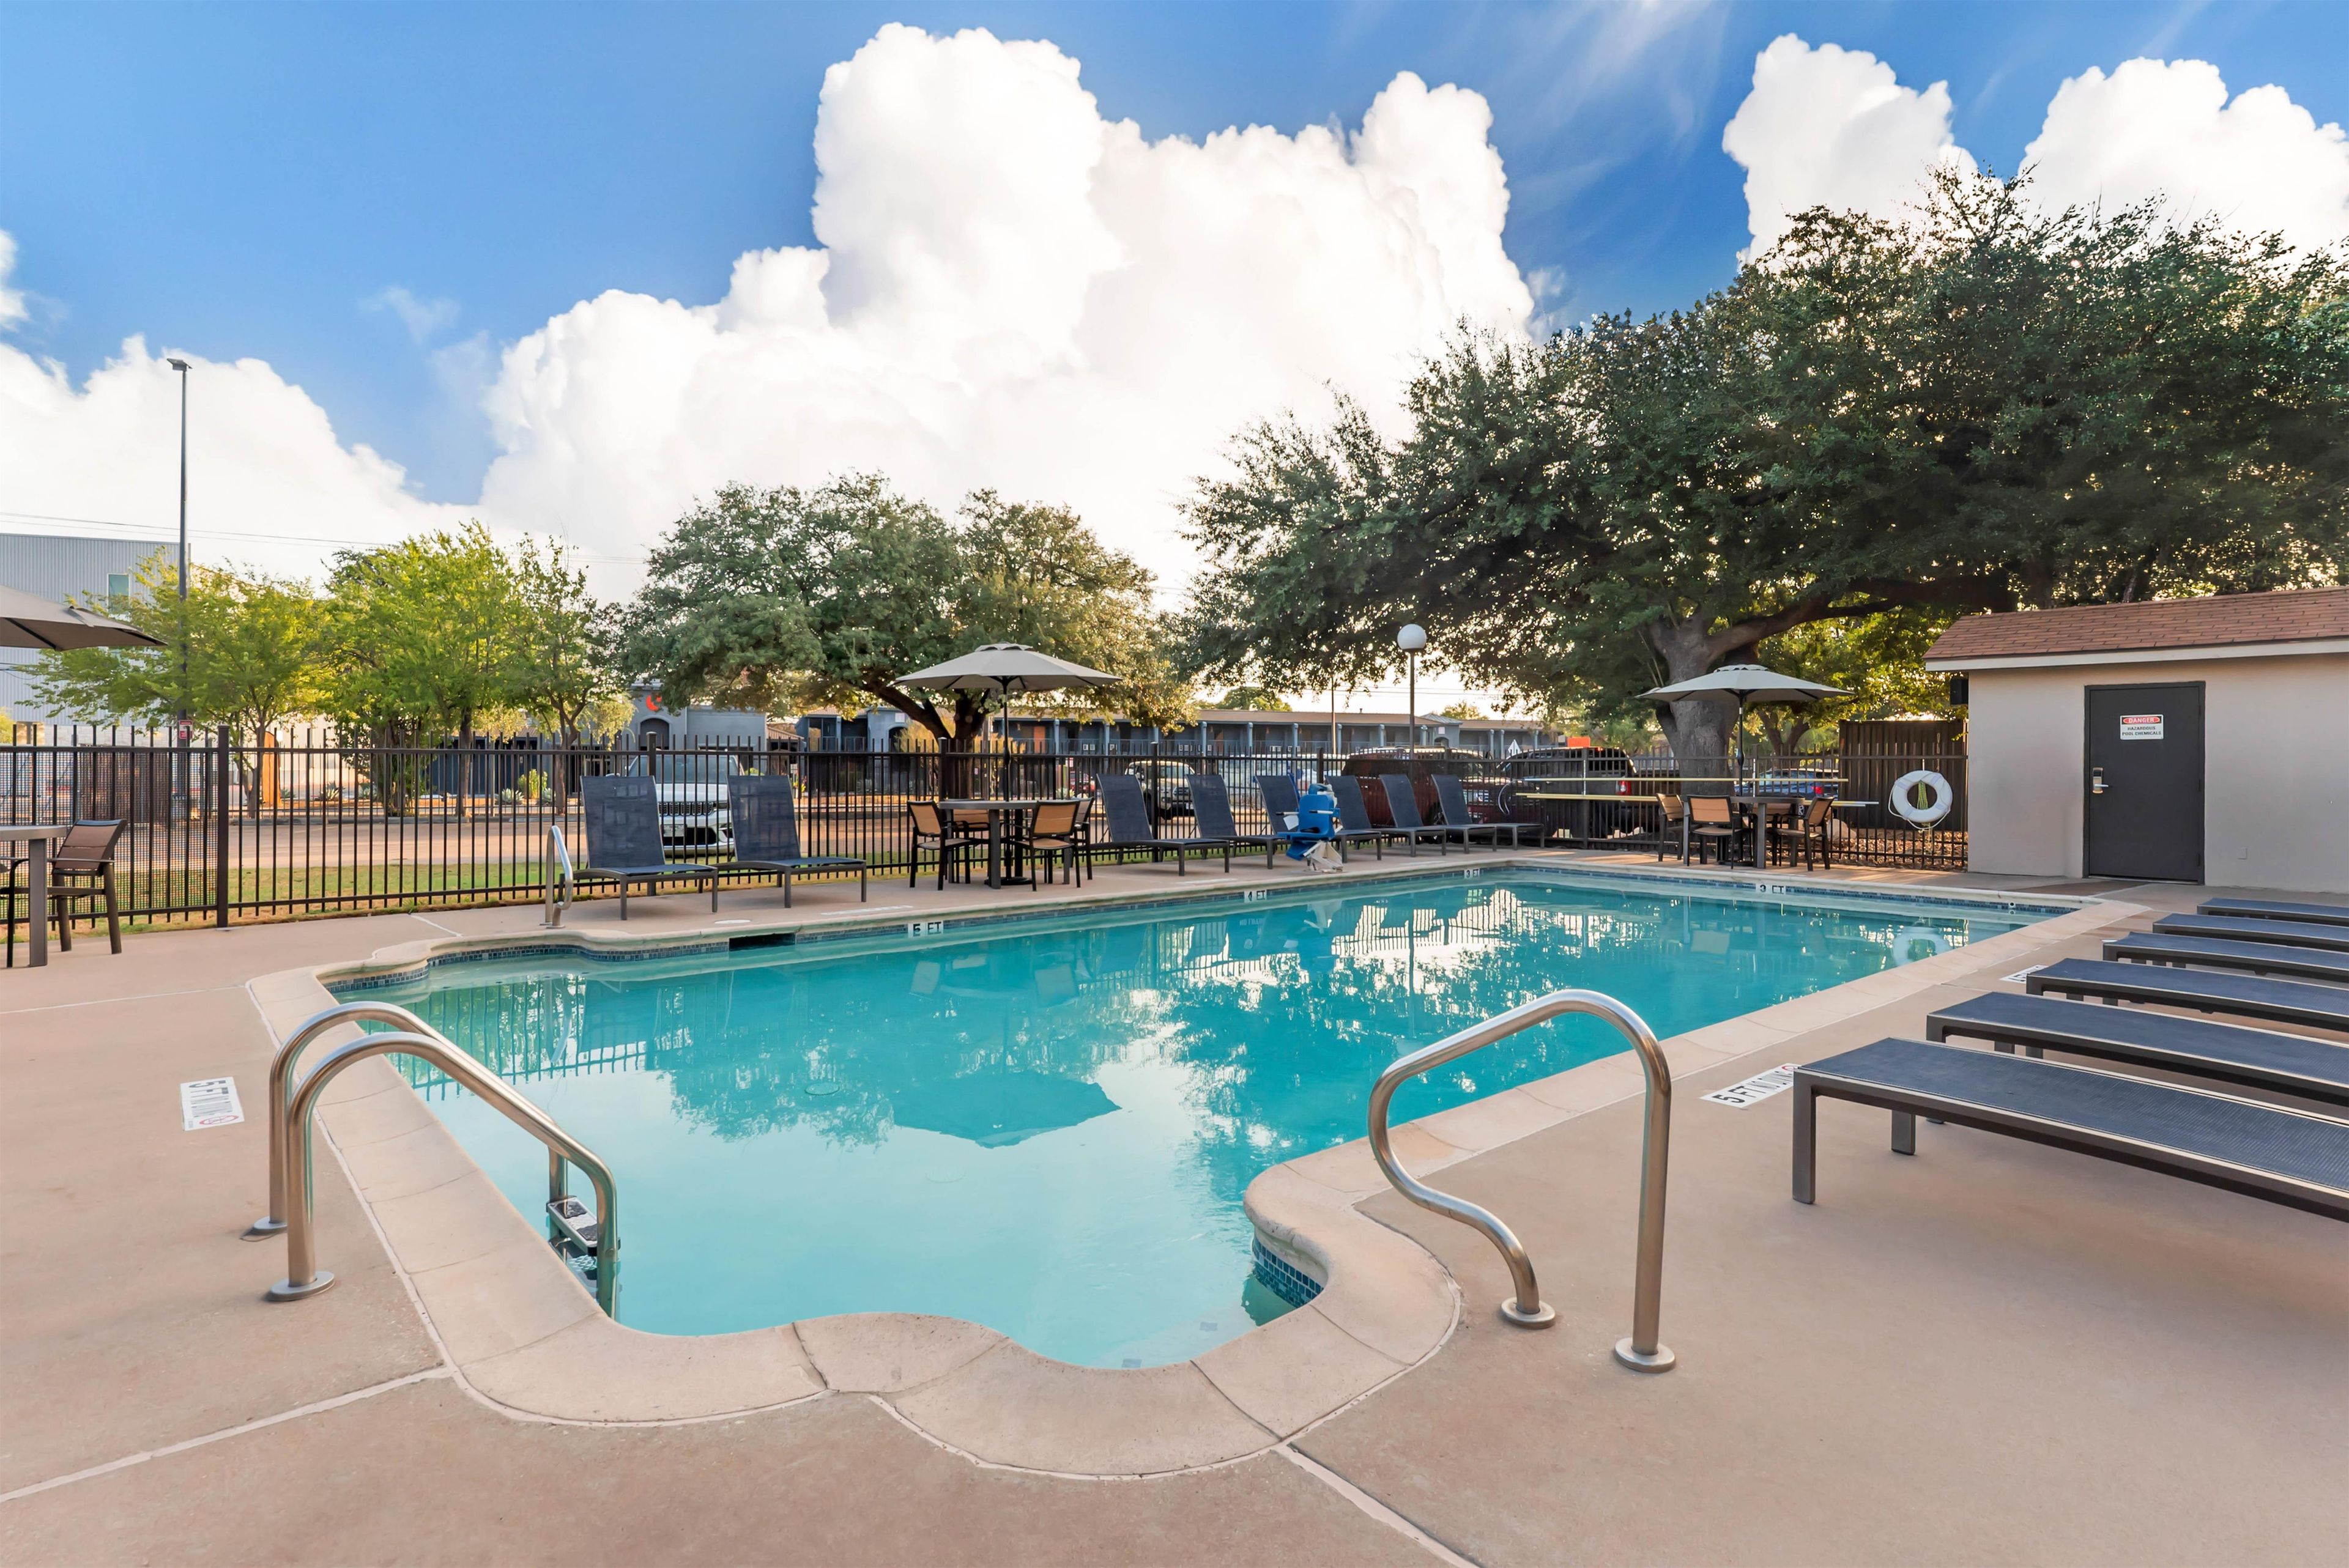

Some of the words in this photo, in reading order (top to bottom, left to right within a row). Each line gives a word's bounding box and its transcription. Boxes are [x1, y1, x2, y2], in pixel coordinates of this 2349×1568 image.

[913, 923, 921, 934] 5
[188, 1079, 226, 1088] 5
[1727, 1085, 1767, 1098] FT
[1712, 1094, 1746, 1103] 5
